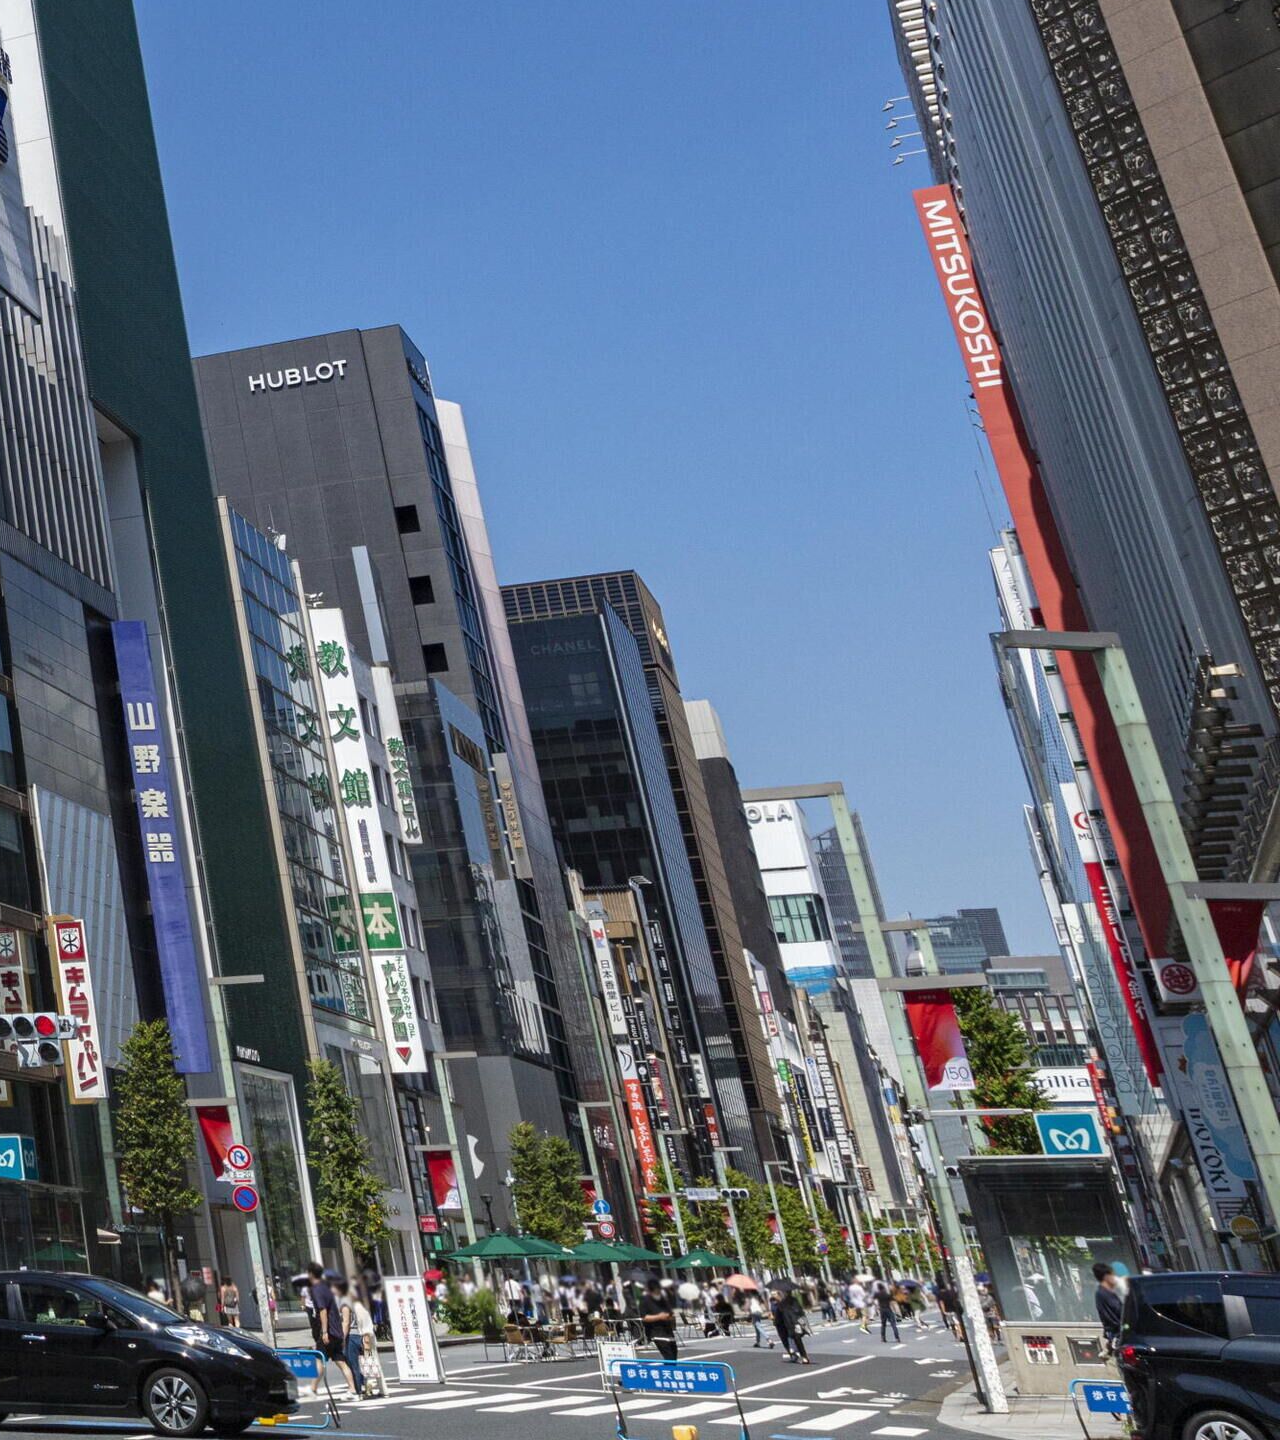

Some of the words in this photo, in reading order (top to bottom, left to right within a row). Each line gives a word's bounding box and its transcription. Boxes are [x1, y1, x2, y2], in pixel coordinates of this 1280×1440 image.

[921, 198, 1005, 389] MITSUKOSHI
[248, 359, 348, 392] HUBLOT
[530, 639, 600, 656] CHANEL
[317, 640, 373, 808] 教文館
[127, 702, 175, 863] 山野楽器
[363, 901, 396, 941] 本
[944, 1066, 970, 1081] 150
[627, 1368, 720, 1382] 歩行者天国実施中
